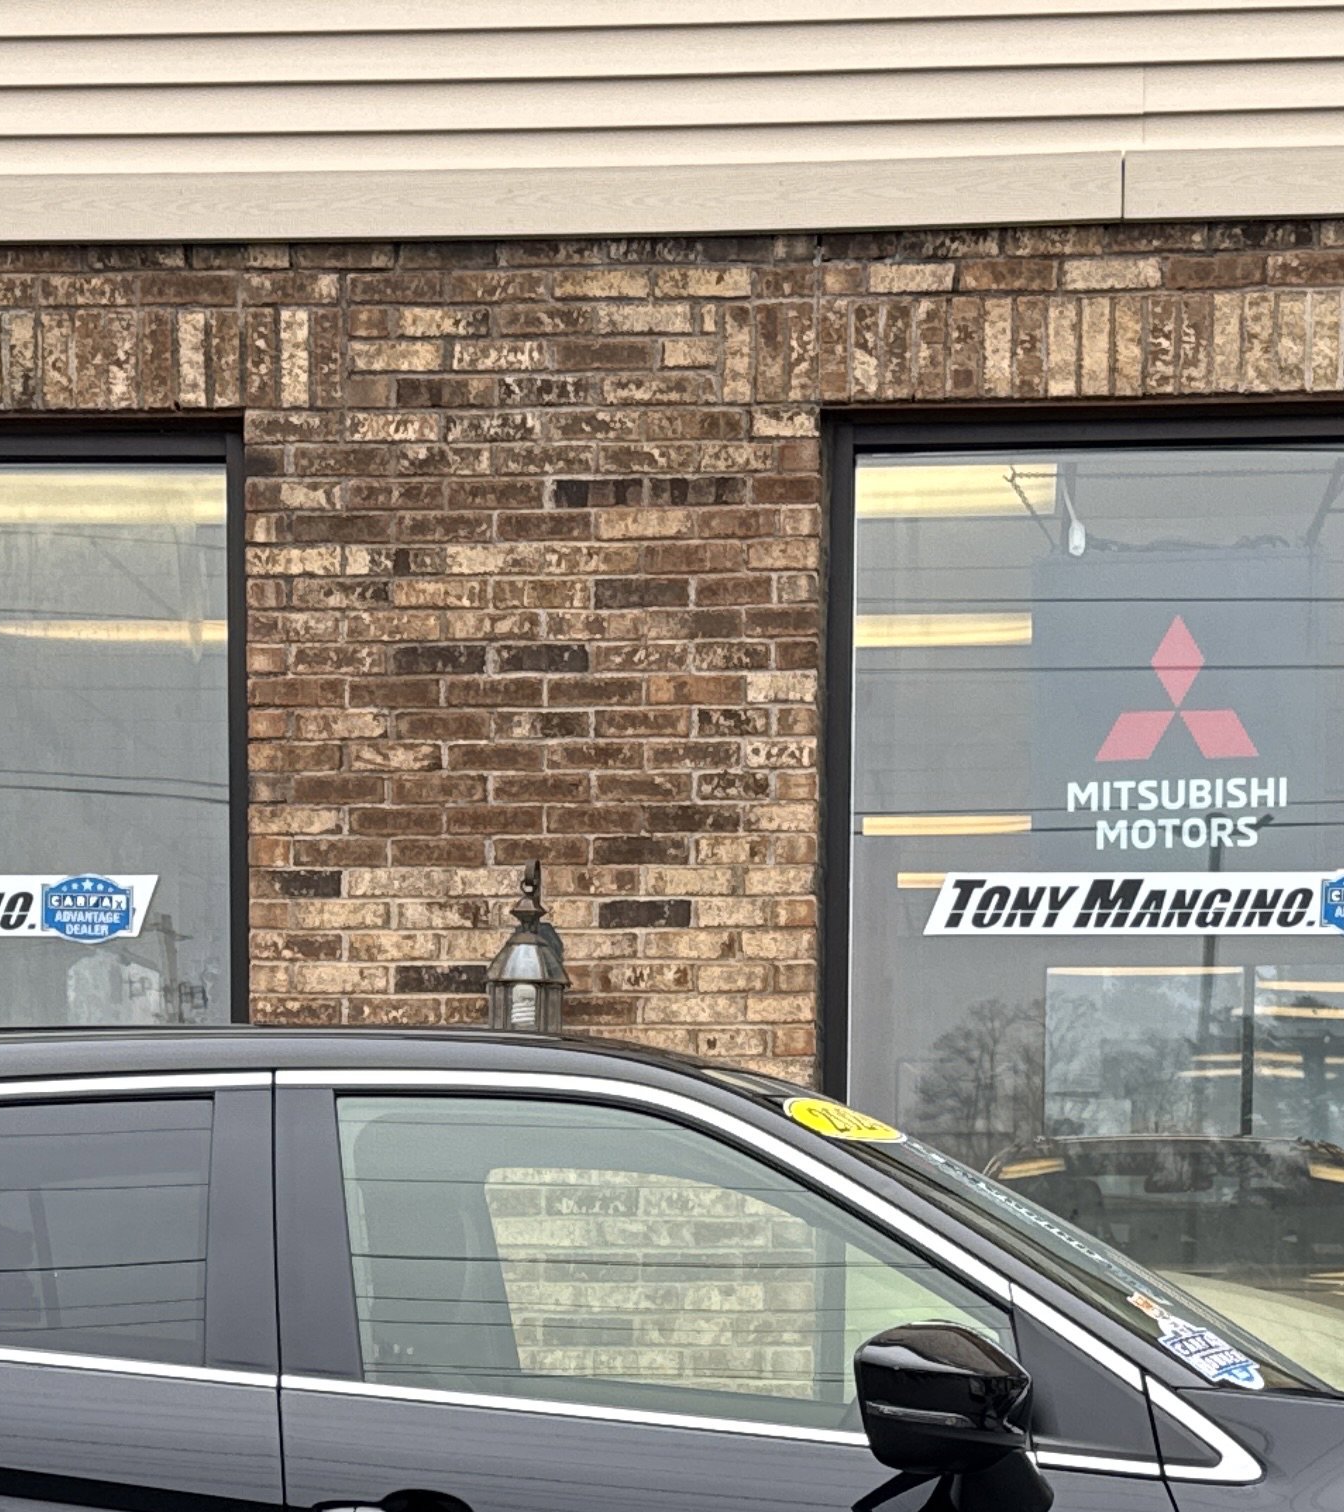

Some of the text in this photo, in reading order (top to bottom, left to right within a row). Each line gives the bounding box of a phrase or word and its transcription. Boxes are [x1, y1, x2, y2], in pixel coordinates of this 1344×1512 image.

[1067, 776, 1288, 813] MITSUBISHI
[1095, 816, 1258, 851] MOTORS
[50, 894, 127, 910] CARFAX
[944, 879, 1079, 928] TONY
[55, 911, 121, 924] ADVANTAGE
[65, 924, 109, 936] DEALER
